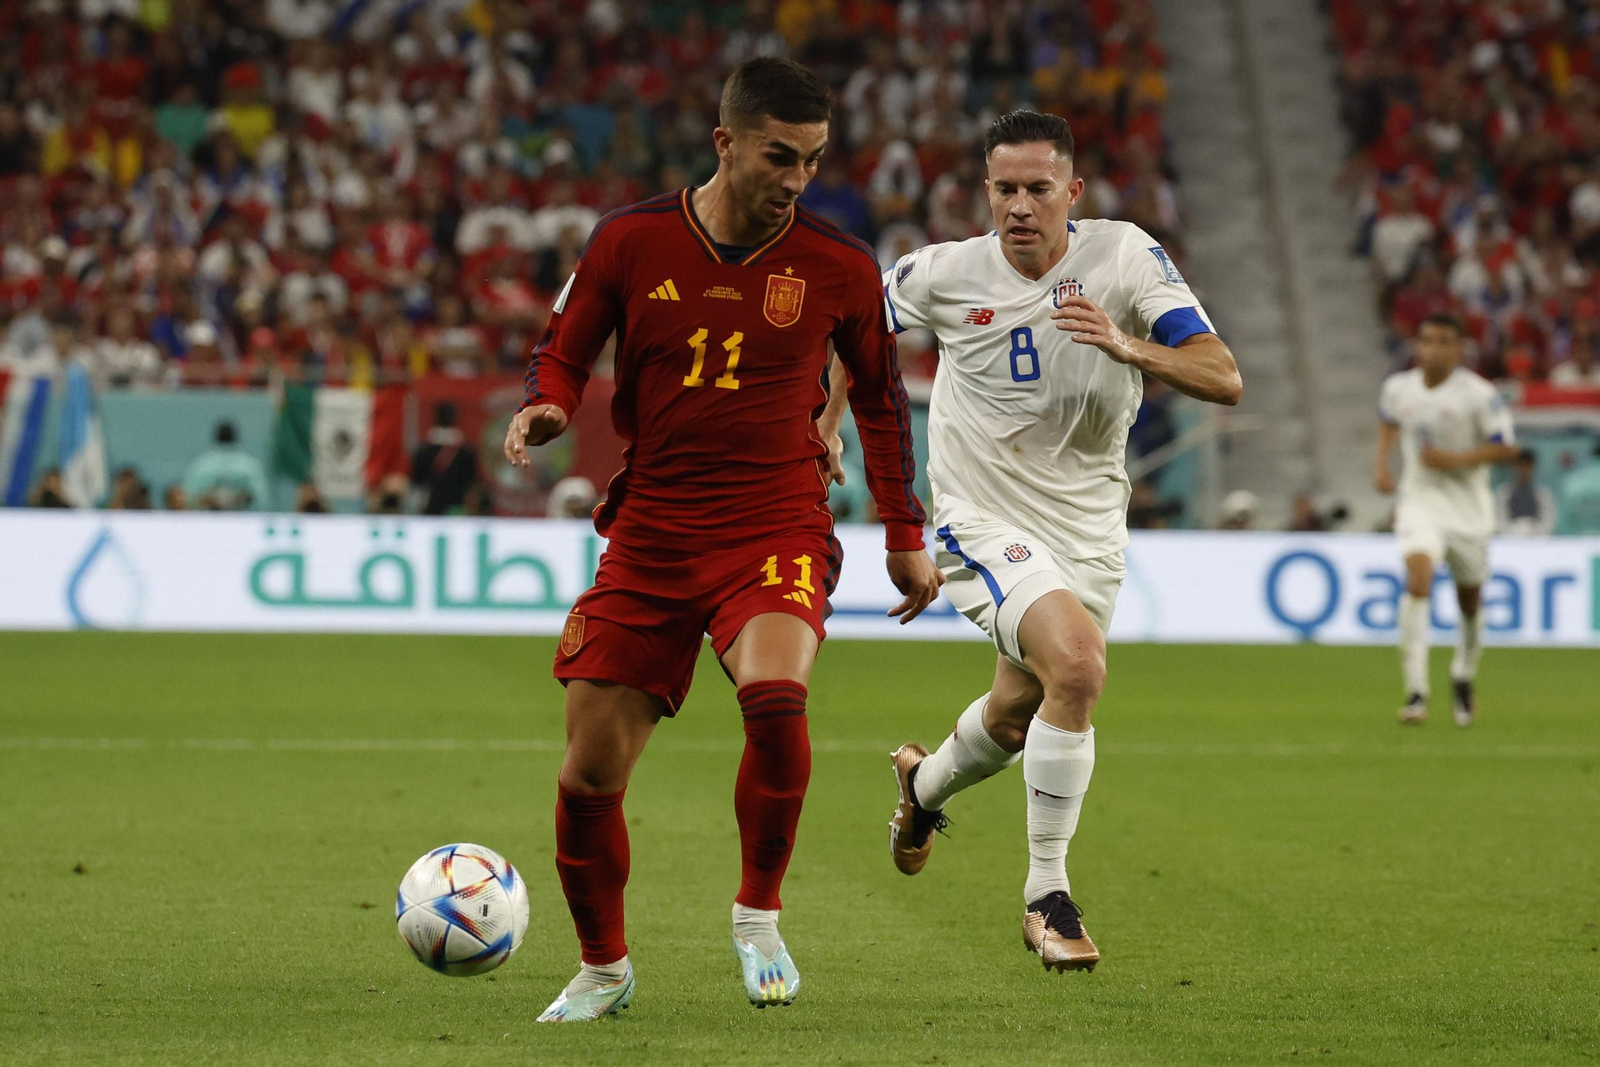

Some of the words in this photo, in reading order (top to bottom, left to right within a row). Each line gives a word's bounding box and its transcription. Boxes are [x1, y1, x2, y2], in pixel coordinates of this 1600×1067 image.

[683, 328, 744, 390] 11
[1009, 326, 1041, 383] 8
[250, 526, 597, 609] لطاقة
[760, 554, 815, 595] 11
